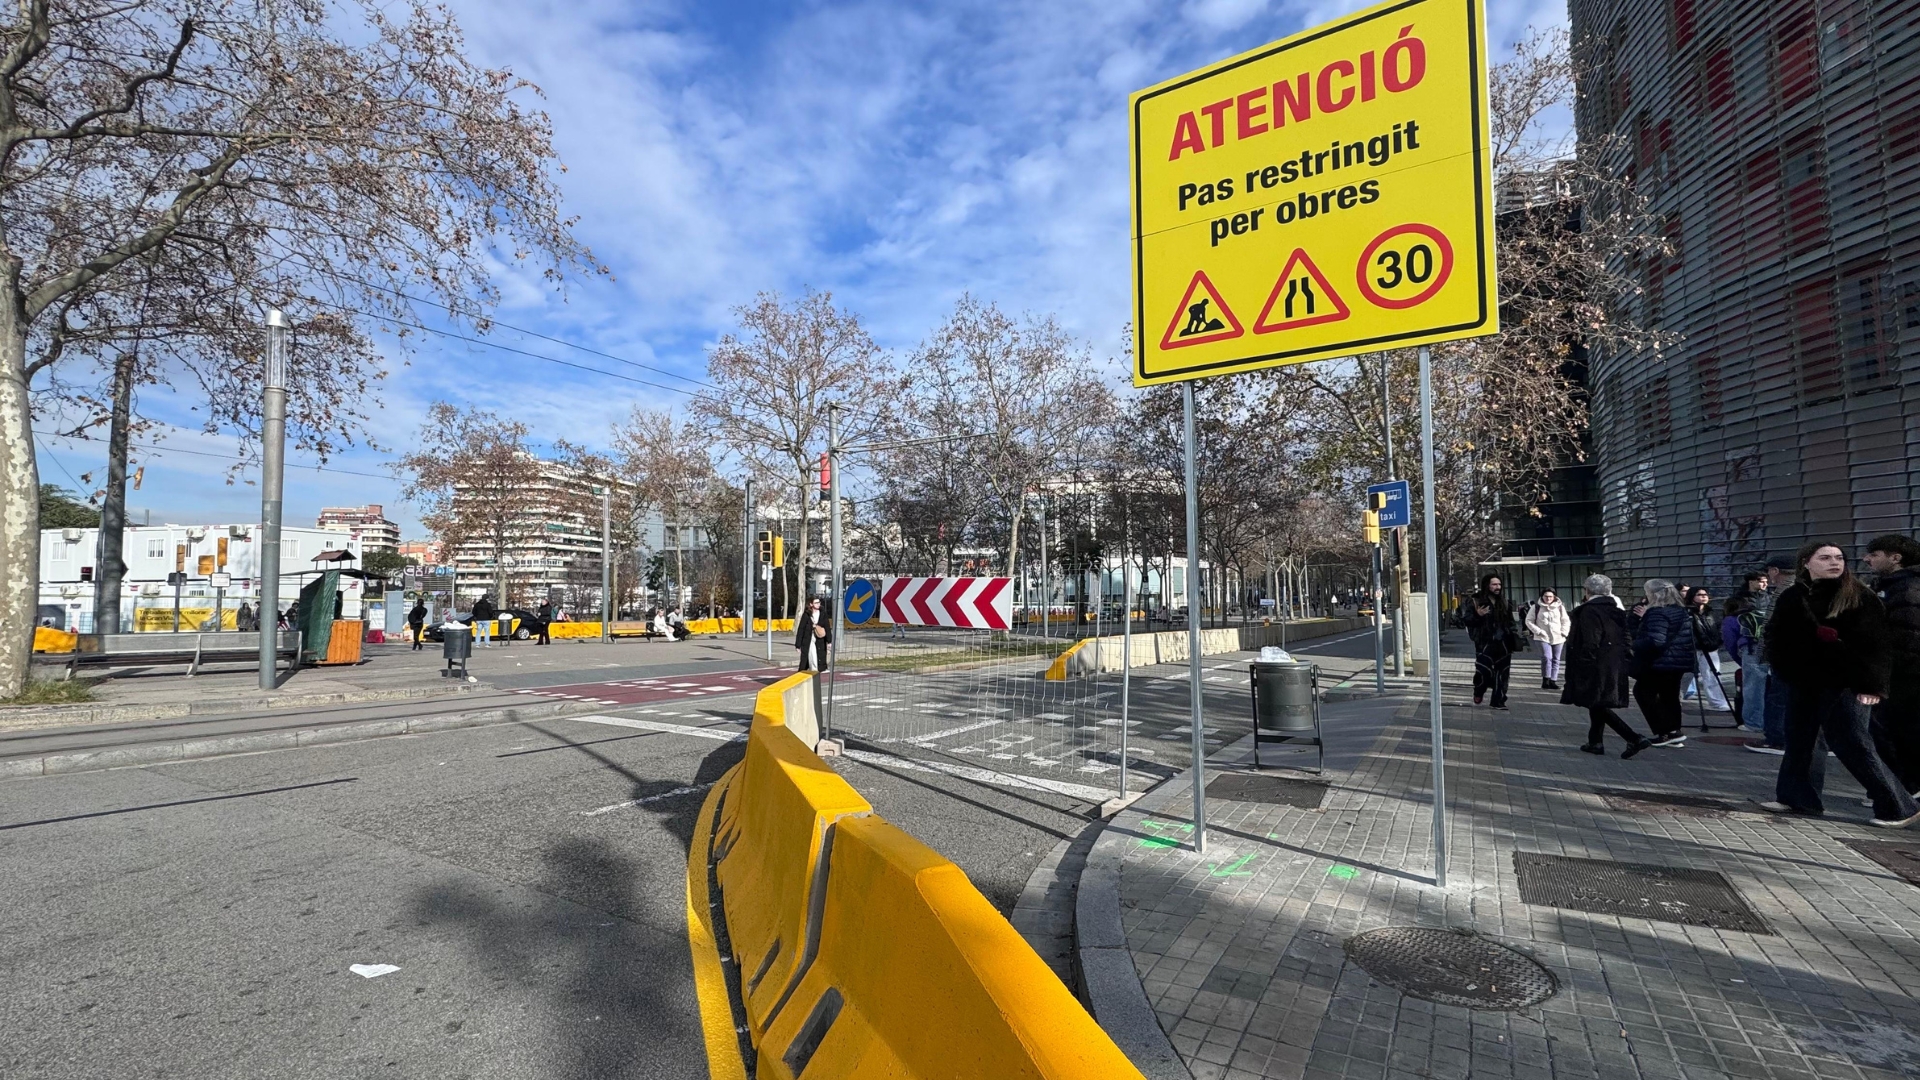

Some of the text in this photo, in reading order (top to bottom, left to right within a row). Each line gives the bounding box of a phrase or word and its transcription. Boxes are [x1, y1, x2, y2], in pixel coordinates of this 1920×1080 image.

[1168, 24, 1426, 161] ATENCIÓ
[1178, 120, 1420, 211] Pas restringit
[1211, 179, 1380, 247] per obres
[1376, 244, 1433, 289] 30
[1380, 511, 1397, 521] taxi
